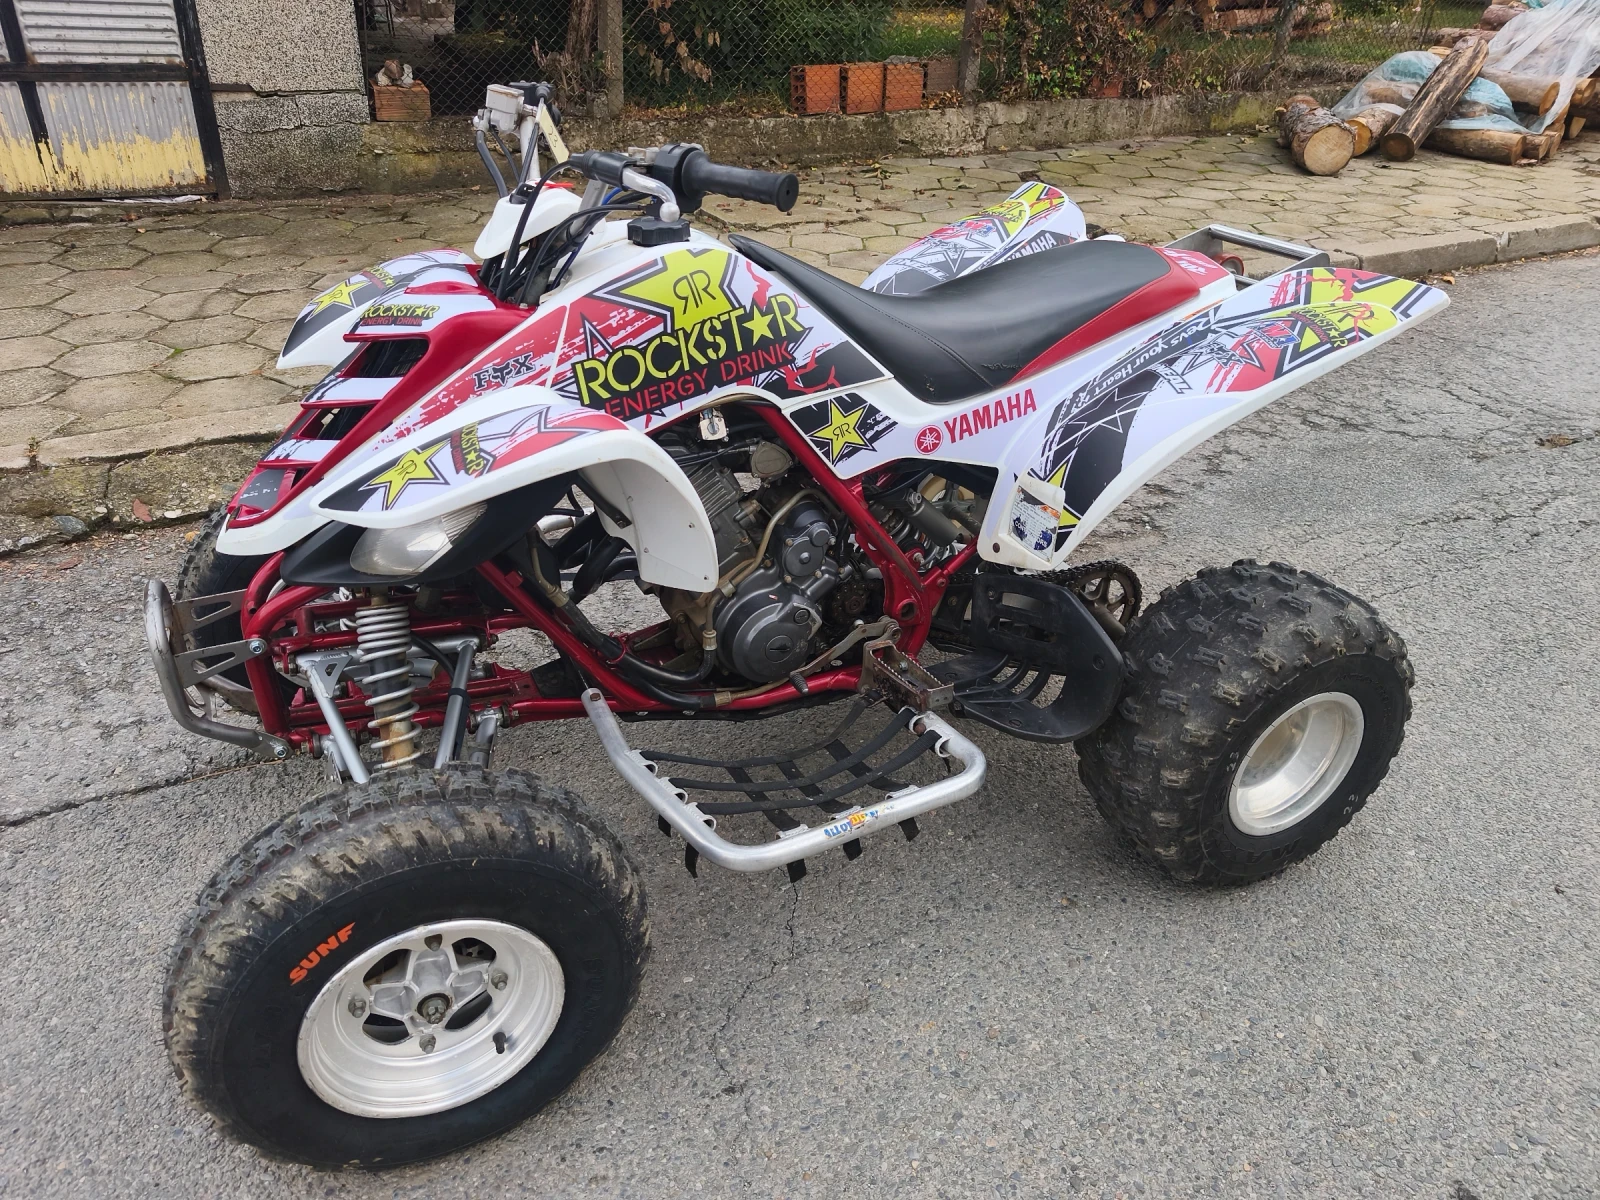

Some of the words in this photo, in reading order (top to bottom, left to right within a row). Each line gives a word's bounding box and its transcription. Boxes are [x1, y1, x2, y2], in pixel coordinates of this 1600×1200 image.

[360, 304, 440, 319] ROCKSTAR
[361, 317, 395, 327] ENERGY
[397, 318, 423, 326] DRINK
[1170, 308, 1217, 347] Revs
[575, 293, 805, 406] ROCKSTAR
[604, 368, 708, 420] ENERGY
[720, 341, 793, 383] DRINK
[1094, 366, 1134, 397] Heart
[944, 388, 1038, 444] YAMAHA
[289, 921, 356, 986] SUNF
